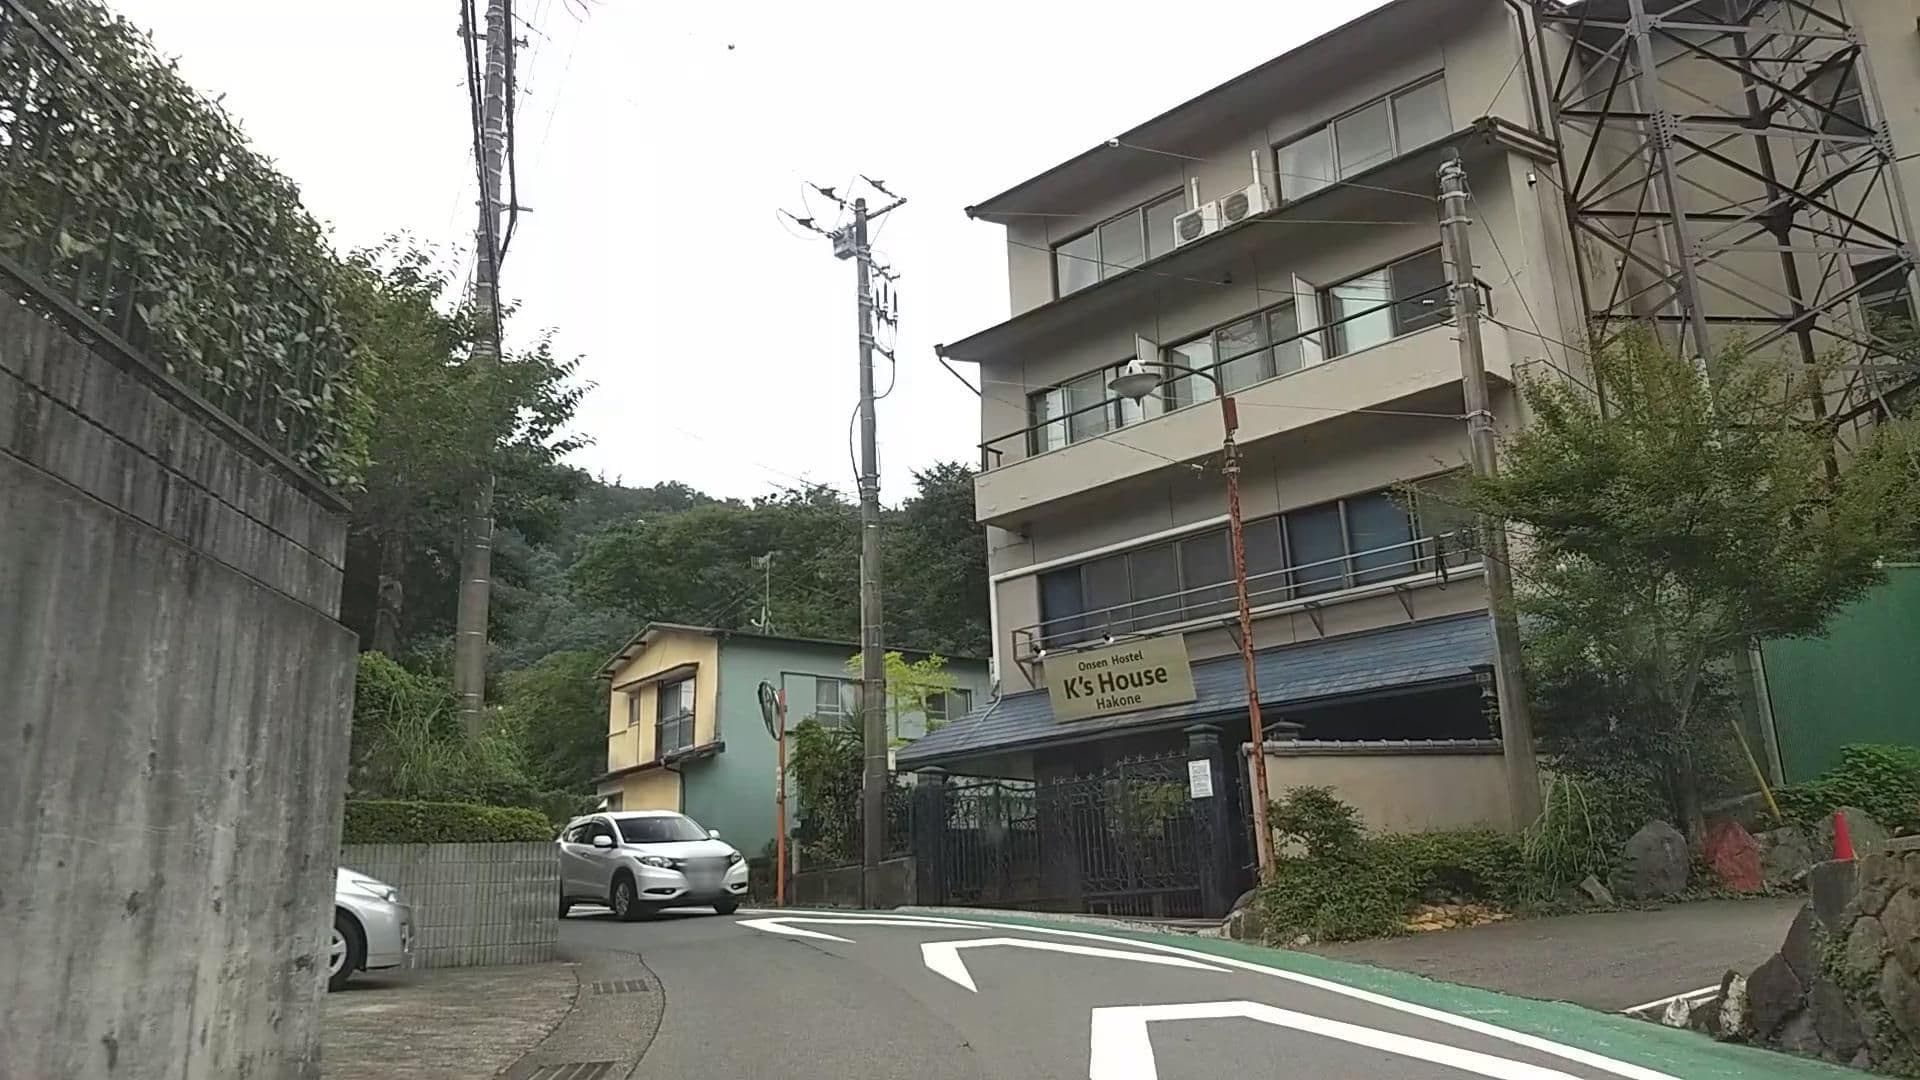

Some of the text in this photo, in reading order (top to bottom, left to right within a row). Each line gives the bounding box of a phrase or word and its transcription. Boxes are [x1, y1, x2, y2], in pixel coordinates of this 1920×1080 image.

[1078, 650, 1144, 671] Onsen Hostel
[1063, 666, 1168, 699] K's House
[1096, 694, 1142, 710] Hakone
